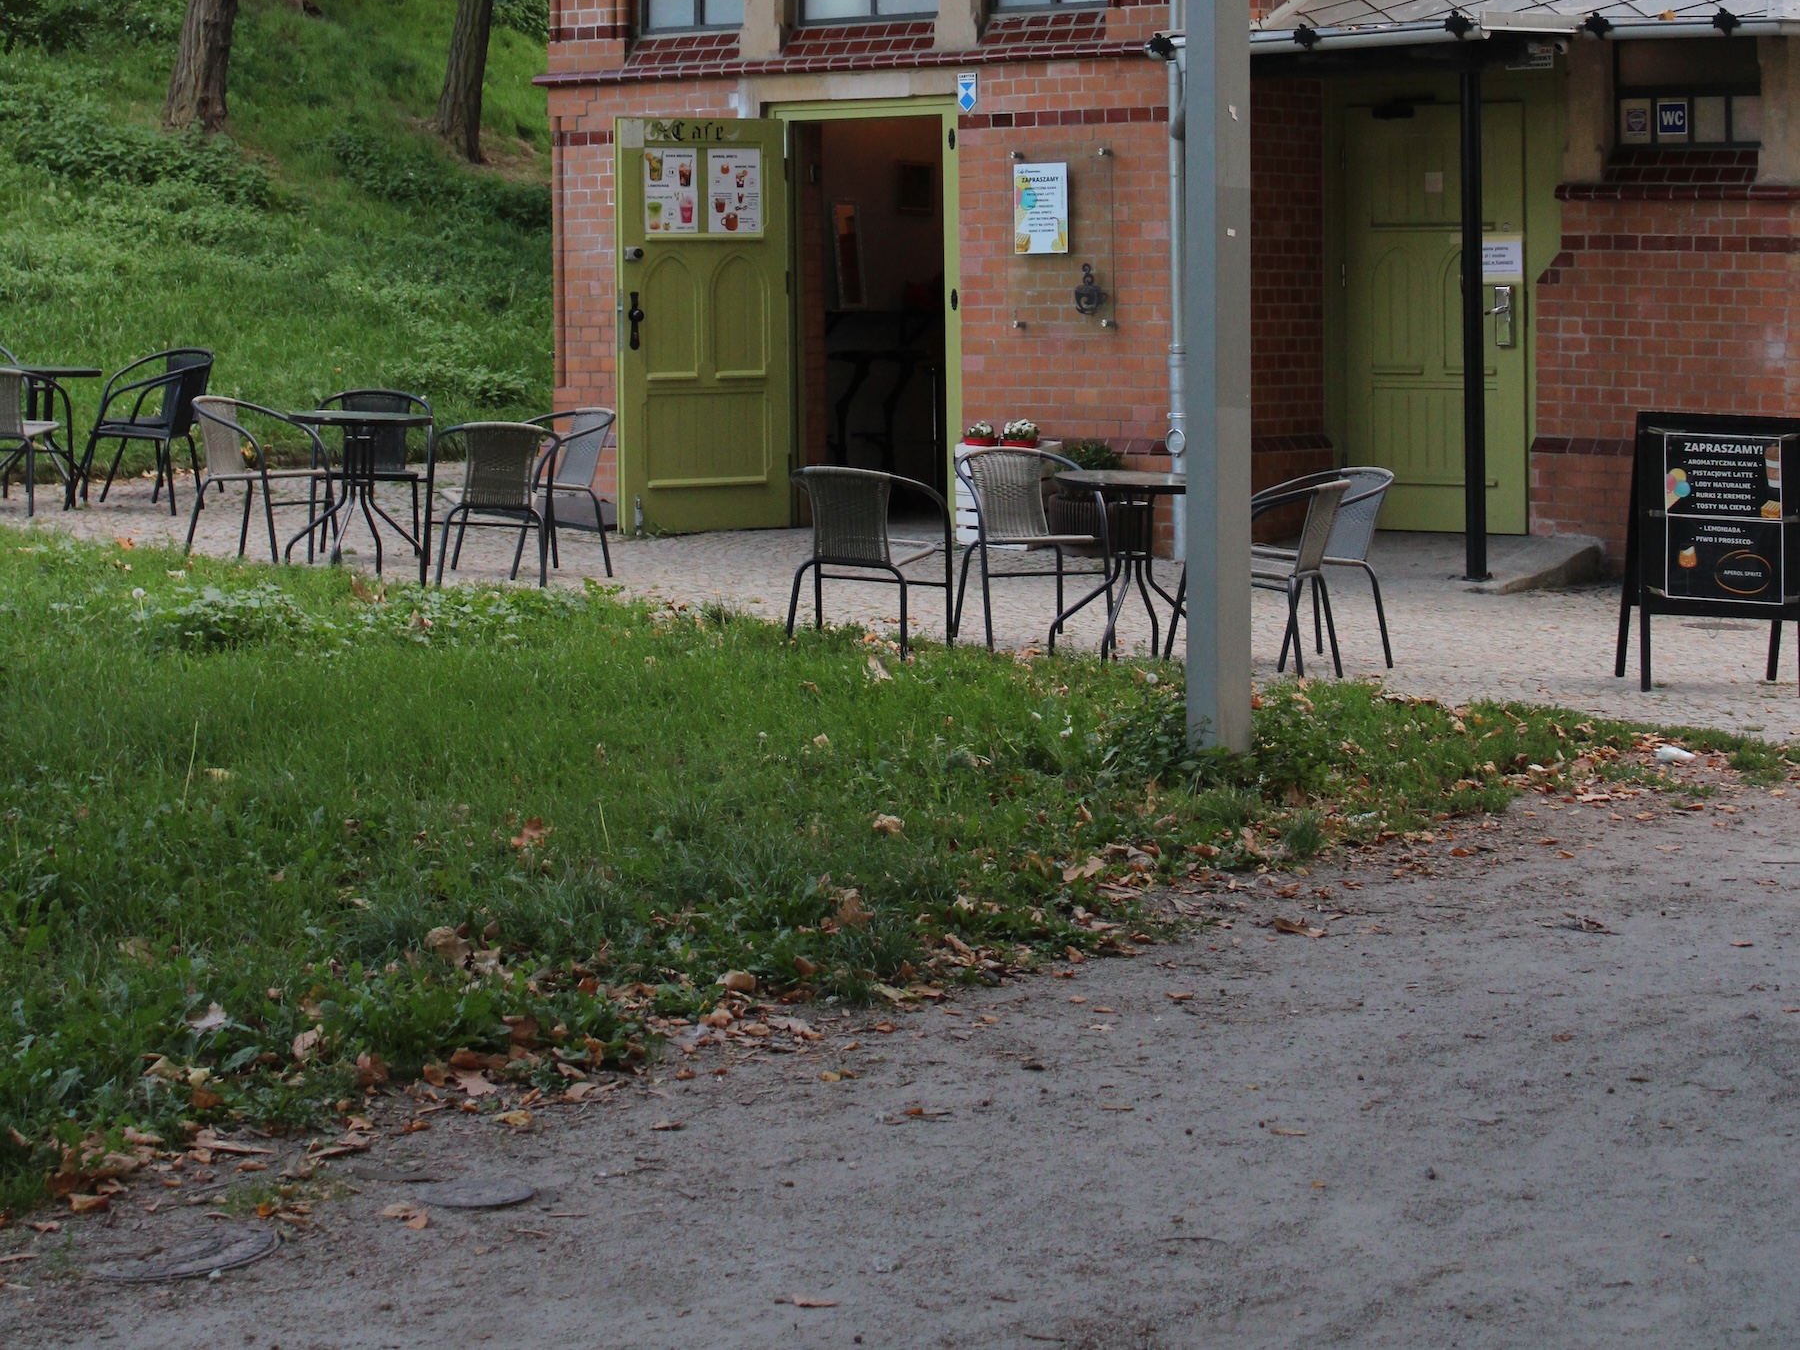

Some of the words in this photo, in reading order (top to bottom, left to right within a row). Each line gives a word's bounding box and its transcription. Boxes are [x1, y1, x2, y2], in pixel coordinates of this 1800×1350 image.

[1661, 110, 1684, 126] WC
[1684, 442, 1763, 454] ZAPRASZAMY!
[1693, 470, 1732, 478] PISTACJOWE
[1695, 491, 1716, 499] RURKI
[1695, 502, 1717, 510] TOSTY
[1703, 525, 1742, 533] LEMONIADA
[1695, 535, 1713, 543] PIWO
[1723, 569, 1744, 577] APEROL
[1744, 570, 1763, 578] SPRITZ
